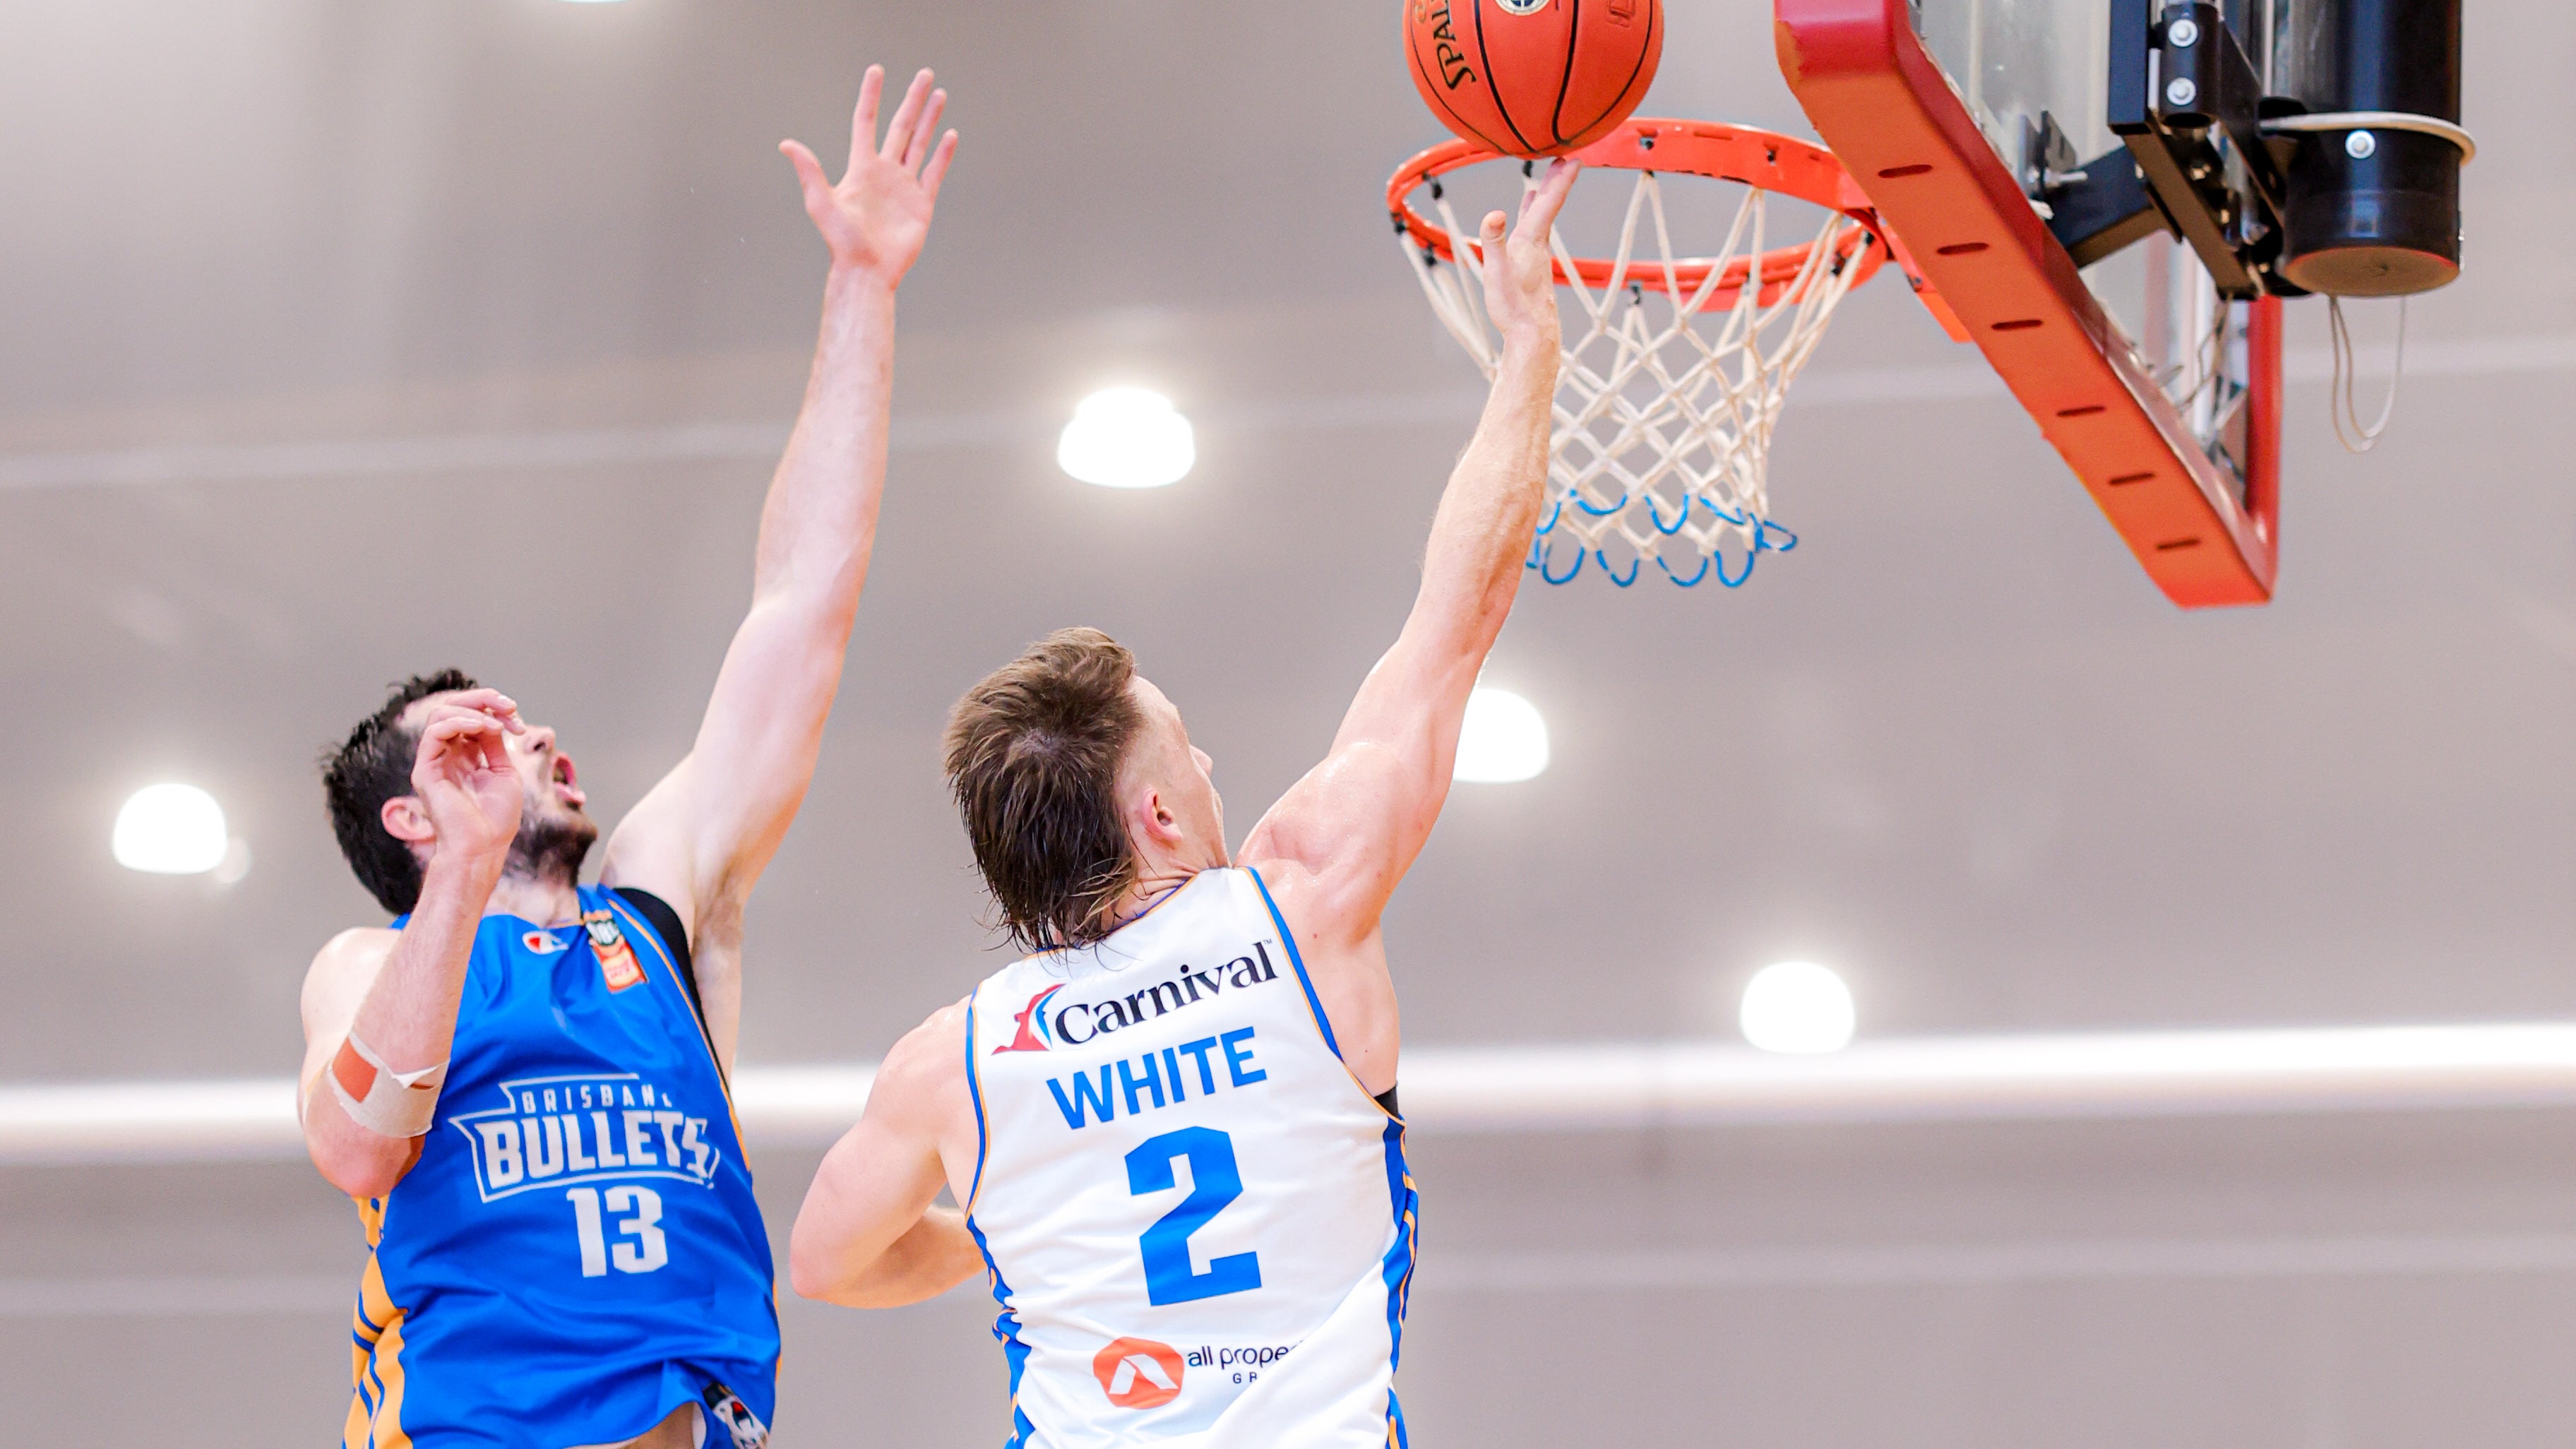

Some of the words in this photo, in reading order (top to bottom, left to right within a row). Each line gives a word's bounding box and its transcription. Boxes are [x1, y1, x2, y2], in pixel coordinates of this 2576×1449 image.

[1431, 0, 1477, 90] SPAL
[1054, 941, 1279, 1045] Carnival
[1046, 1025, 1268, 1130] WHITE
[474, 1109, 710, 1190] BULLETS
[566, 1185, 669, 1278] 13
[1124, 1126, 1262, 1307] 2
[1187, 1345, 1214, 1367] all
[1220, 1340, 1304, 1370] prope
